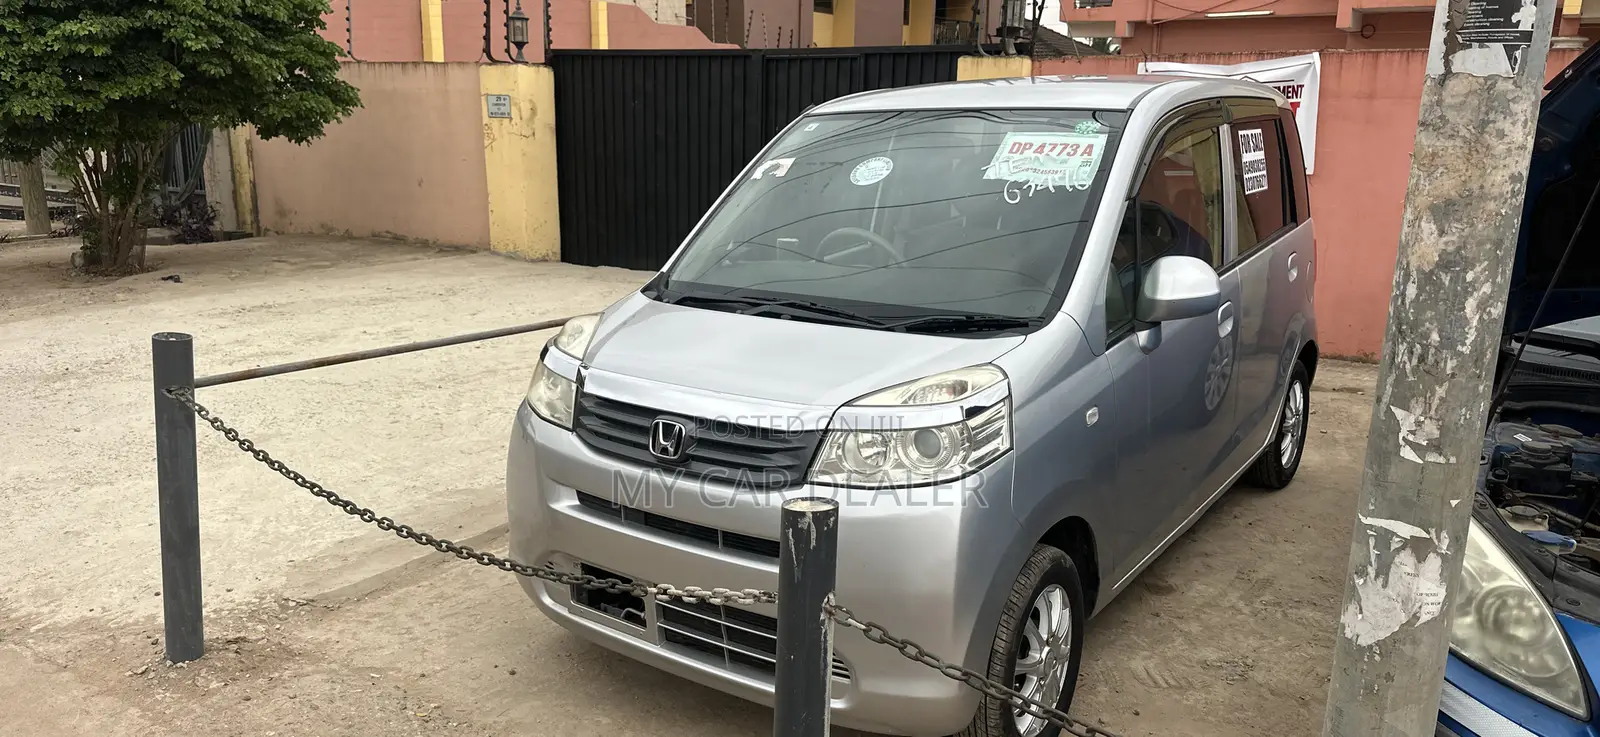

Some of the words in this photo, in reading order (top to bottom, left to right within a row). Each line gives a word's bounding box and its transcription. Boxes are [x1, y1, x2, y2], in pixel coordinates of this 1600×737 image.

[1272, 84, 1304, 99] MENT
[1008, 141, 1034, 155] DP
[1080, 143, 1095, 157] A
